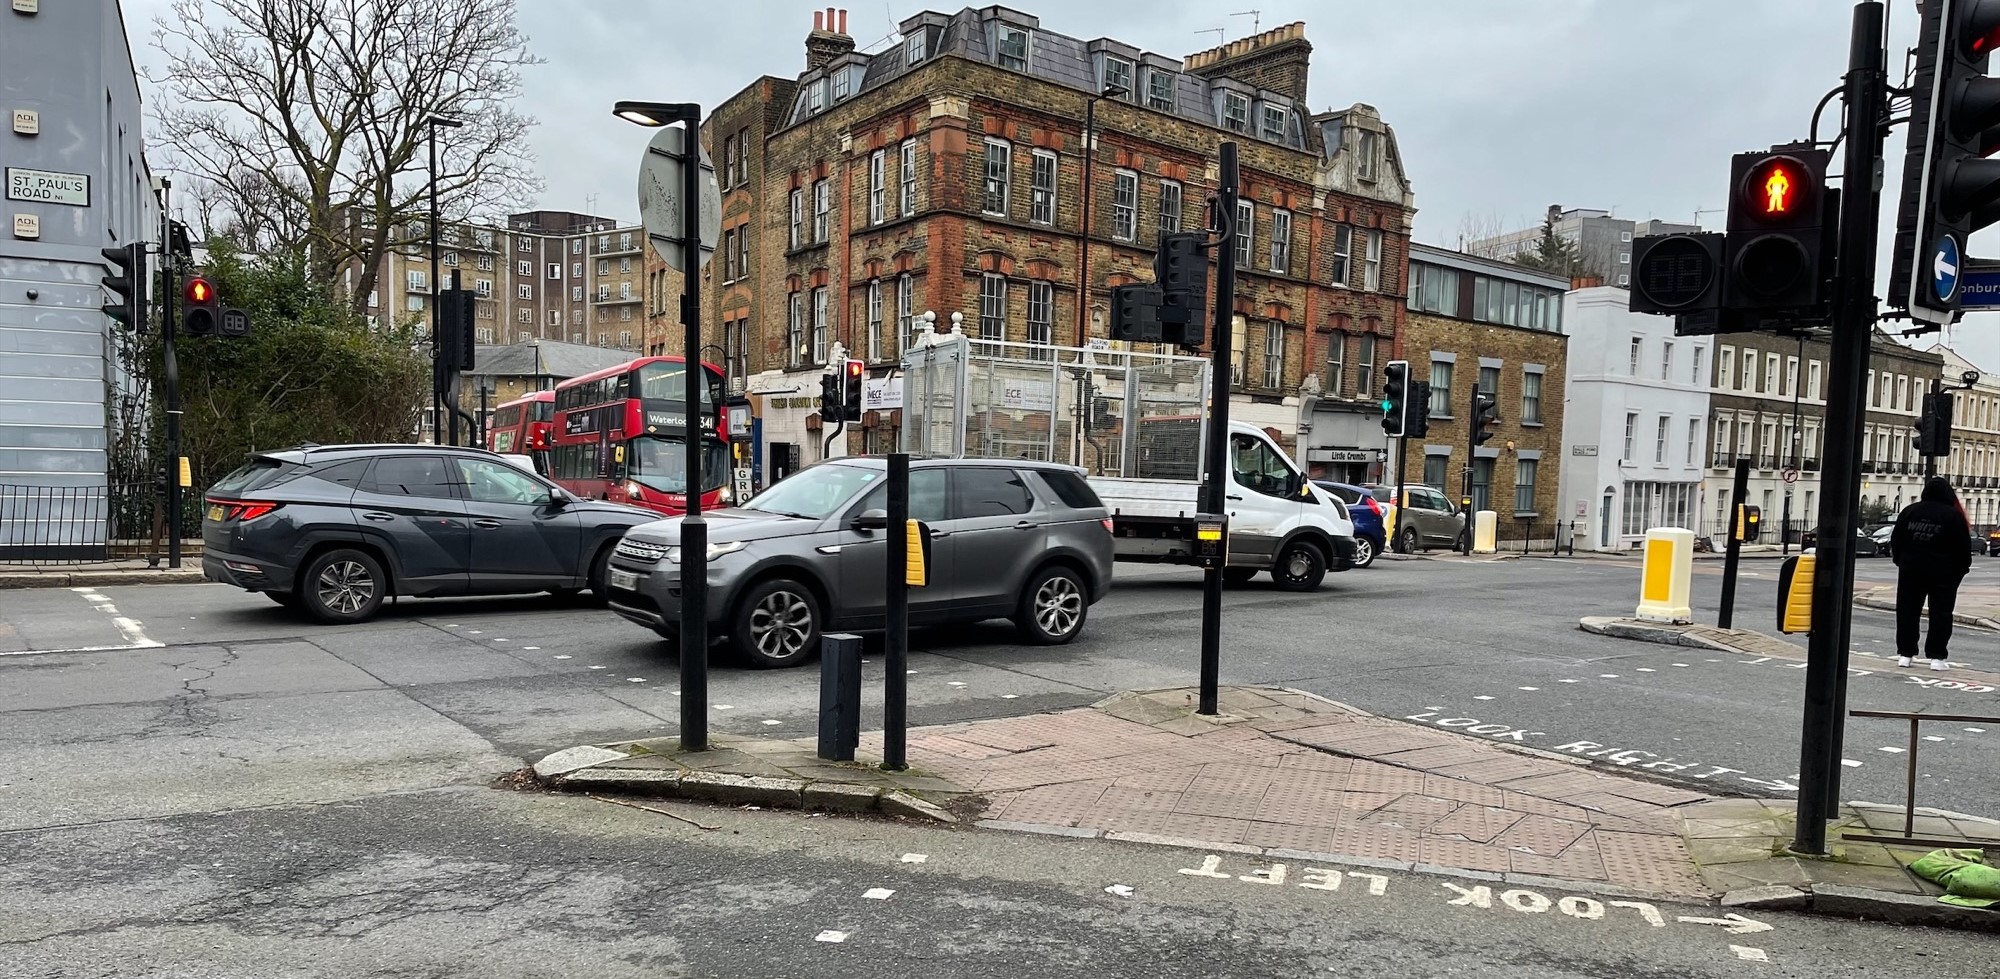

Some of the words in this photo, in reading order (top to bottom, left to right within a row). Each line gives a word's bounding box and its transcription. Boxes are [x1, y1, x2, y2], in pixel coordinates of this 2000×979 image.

[14, 176, 33, 187] ST.
[38, 178, 83, 192] PAUL'S
[13, 187, 51, 199] ROAD
[700, 416, 713, 429] 341
[1332, 451, 1346, 460] Little
[1347, 452, 1367, 460] Crumbs
[1907, 521, 1942, 533] WHITE
[1406, 705, 1546, 742] LOOK
[1553, 740, 1748, 779] RIGHT
[1177, 854, 1390, 896] LEFT
[1441, 882, 1627, 928] LOOK
